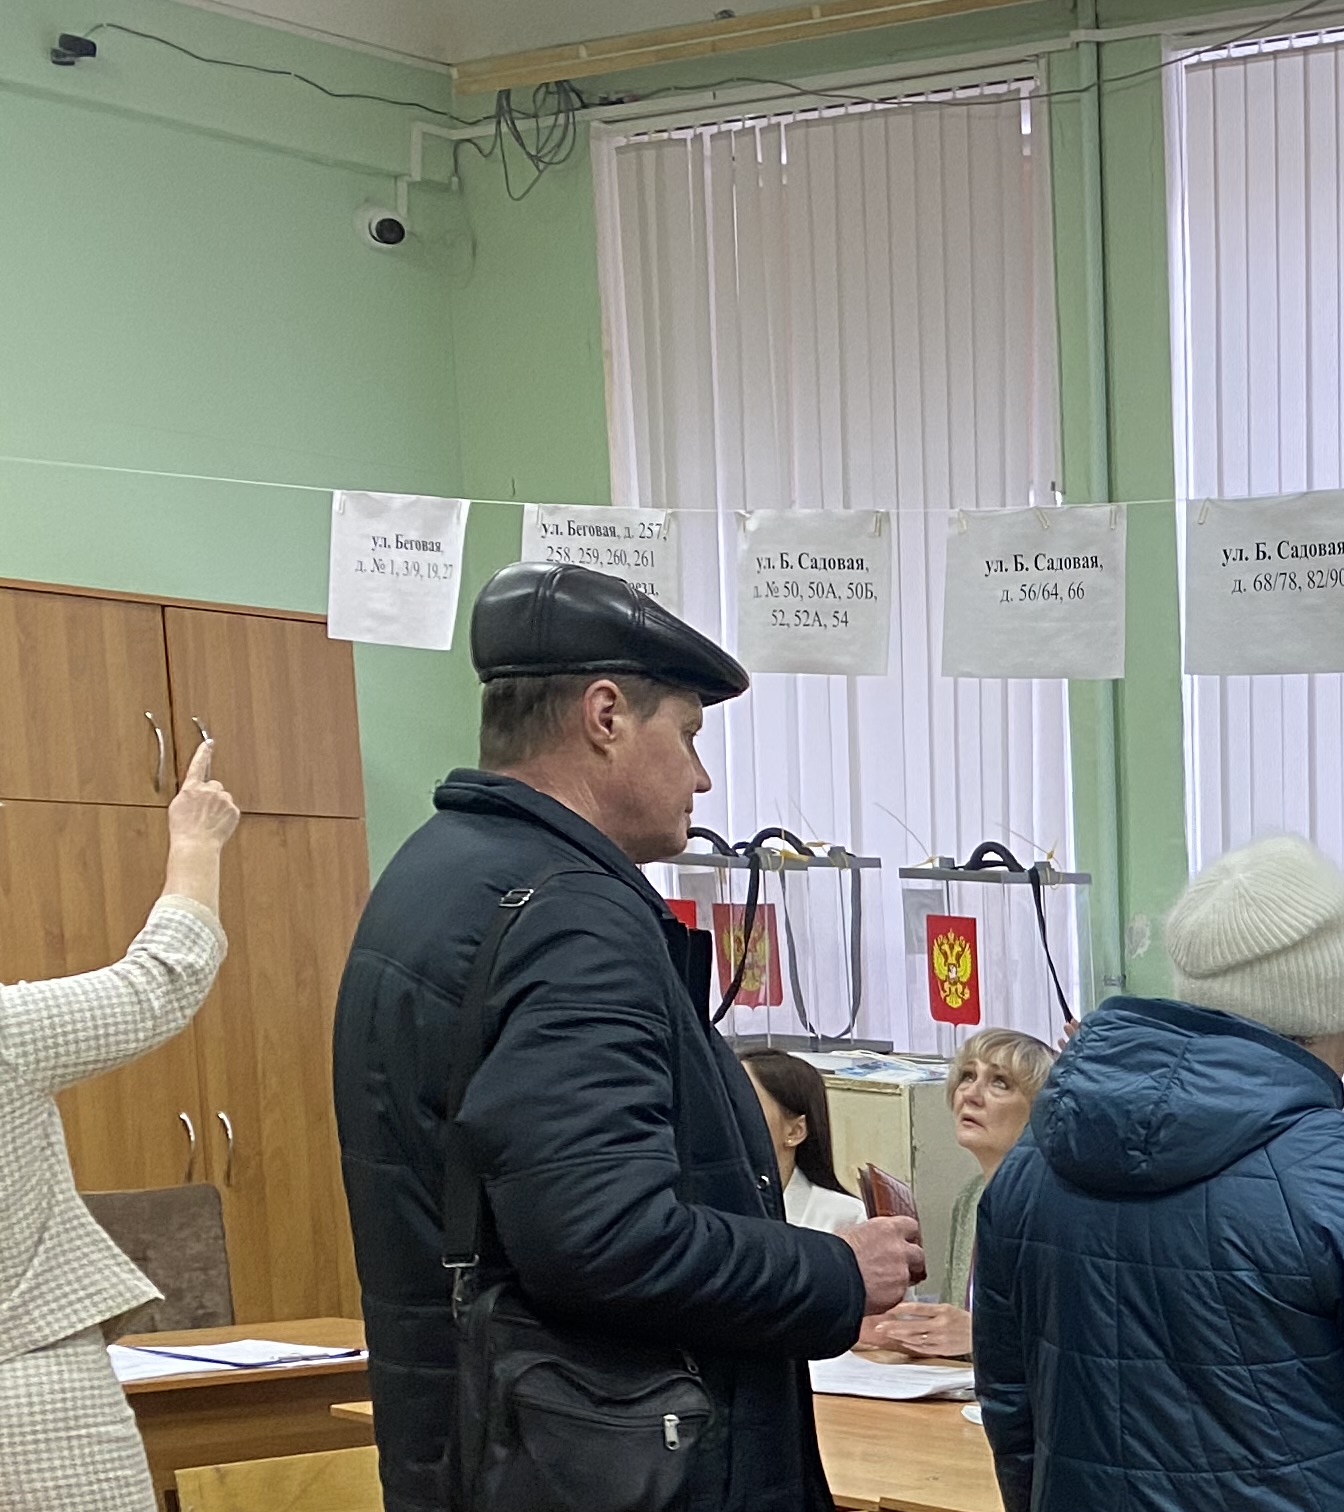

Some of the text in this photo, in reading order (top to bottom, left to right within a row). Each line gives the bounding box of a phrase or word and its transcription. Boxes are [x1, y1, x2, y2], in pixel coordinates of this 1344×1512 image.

[541, 523, 563, 539] ул.
[567, 520, 621, 539] Беговая,
[638, 523, 667, 541] 257,
[371, 536, 391, 551] ул.
[1221, 548, 1249, 567] ул.
[1255, 541, 1272, 561] Б.
[355, 560, 367, 573] д.
[370, 558, 386, 574] №
[578, 547, 604, 567] 259,
[607, 549, 631, 568] 260,
[634, 550, 655, 568] 261
[756, 552, 870, 574] ул. Б. Садовая,
[984, 552, 1104, 577] ул. Б. Садовая,
[765, 581, 780, 598] №
[783, 581, 804, 601] 50,
[808, 581, 841, 600] 50А,
[846, 582, 878, 603] 50Б,
[1000, 581, 1085, 603] д. 56/64, 66
[1231, 579, 1247, 595] д.
[1253, 571, 1302, 592] 68/78,
[771, 609, 849, 630] 52, 52А, 54
